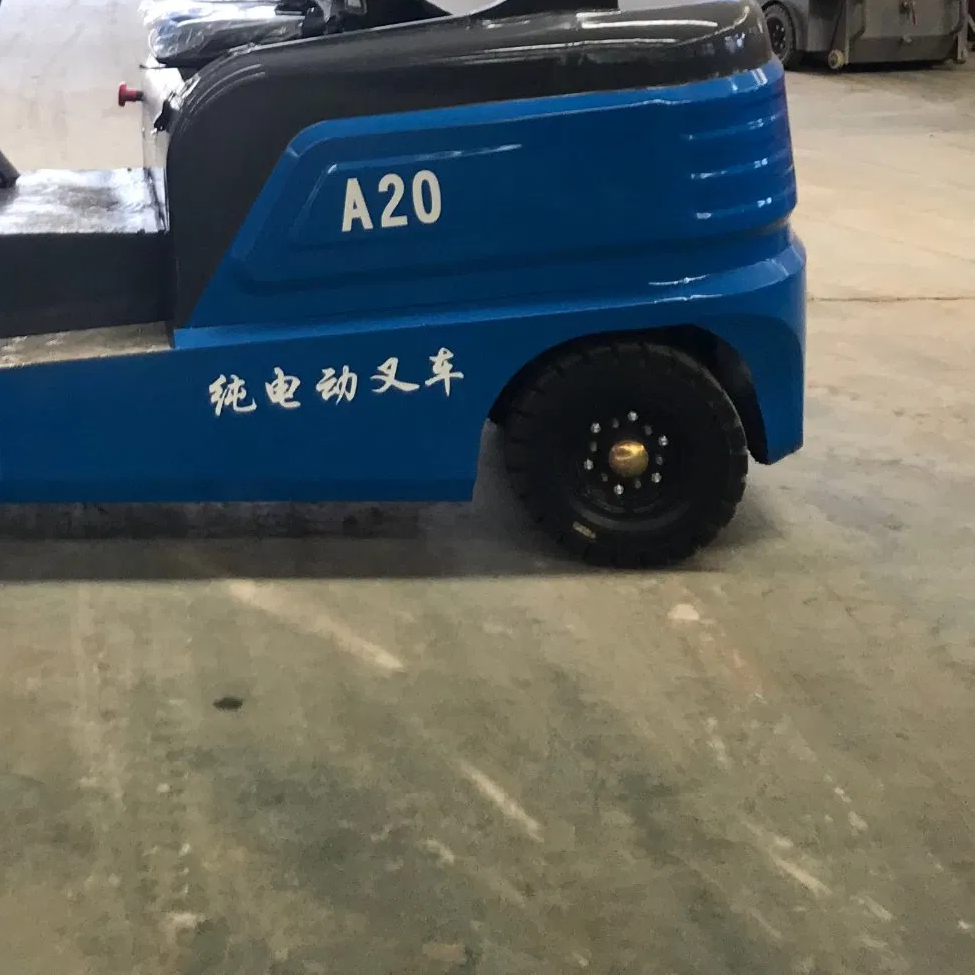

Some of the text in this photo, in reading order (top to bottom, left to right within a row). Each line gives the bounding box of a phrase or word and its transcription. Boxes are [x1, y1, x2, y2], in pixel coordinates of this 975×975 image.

[341, 168, 443, 233] A20
[207, 346, 466, 418] 纯电动叉车
